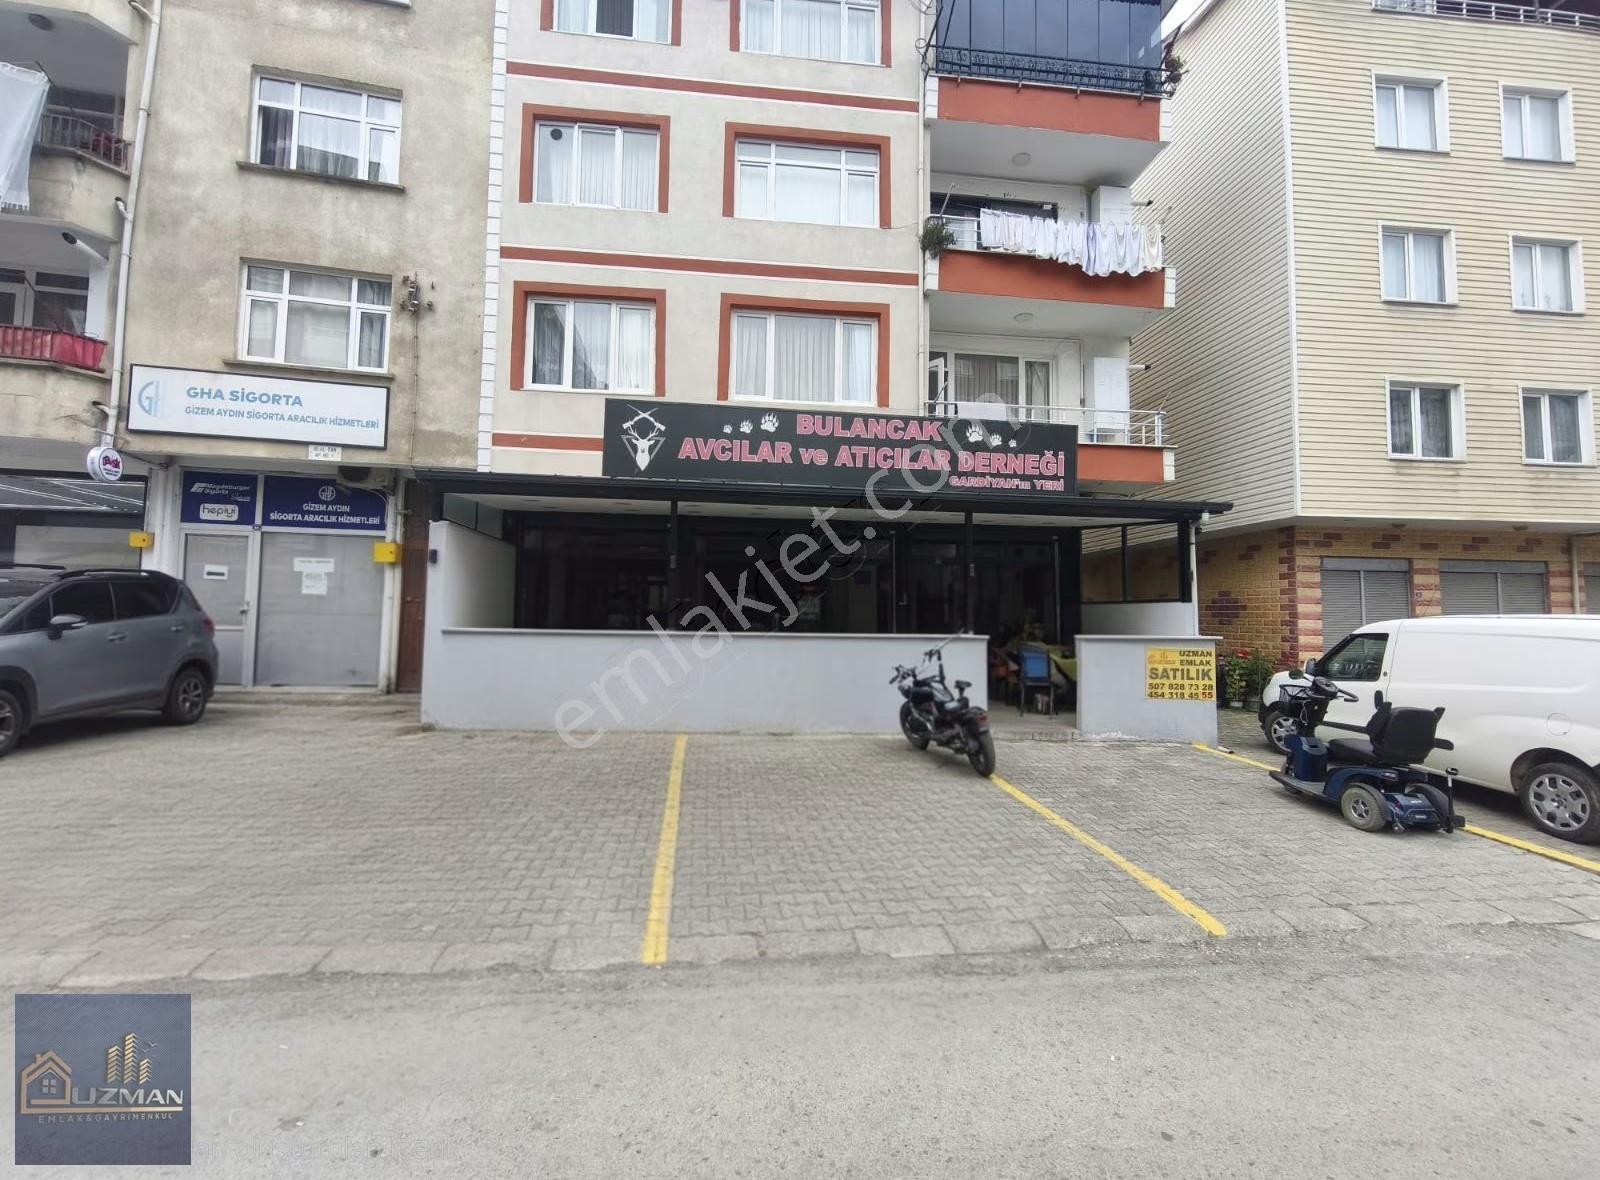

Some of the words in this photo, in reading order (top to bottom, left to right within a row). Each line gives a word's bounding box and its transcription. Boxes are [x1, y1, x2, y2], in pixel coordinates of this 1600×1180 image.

[186, 386, 225, 401] GHA
[229, 387, 303, 407] SİGORTA
[184, 405, 215, 416] GİZEM
[216, 408, 245, 420] AYDIN
[246, 408, 286, 422] SİGORTA
[287, 413, 328, 426] ARACILIK
[329, 415, 380, 429] HİZMETLERİ
[796, 413, 943, 442] BULANCAK
[677, 437, 793, 464] AVCILAR
[799, 447, 829, 466] ve
[833, 445, 951, 471] ATICILAR
[958, 450, 1065, 477] DERNEĞİ
[1033, 478, 1064, 491] YERİ
[302, 501, 327, 511] GİZEM
[327, 504, 350, 512] AYDIN
[270, 510, 302, 521] SİGORTA
[303, 514, 338, 523] ARACILIK
[338, 514, 380, 525] HİZMETLERİ
[1179, 659, 1211, 667] EMLAK
[1148, 667, 1212, 681] SATILIK
[1148, 682, 1165, 691] 507
[1168, 683, 1185, 691] 828
[1188, 683, 1199, 691] 73
[1201, 683, 1214, 691] 28
[1148, 691, 1165, 699] 454
[1168, 691, 1185, 699] 318
[1188, 691, 1199, 699] 45
[1201, 691, 1213, 699] 55
